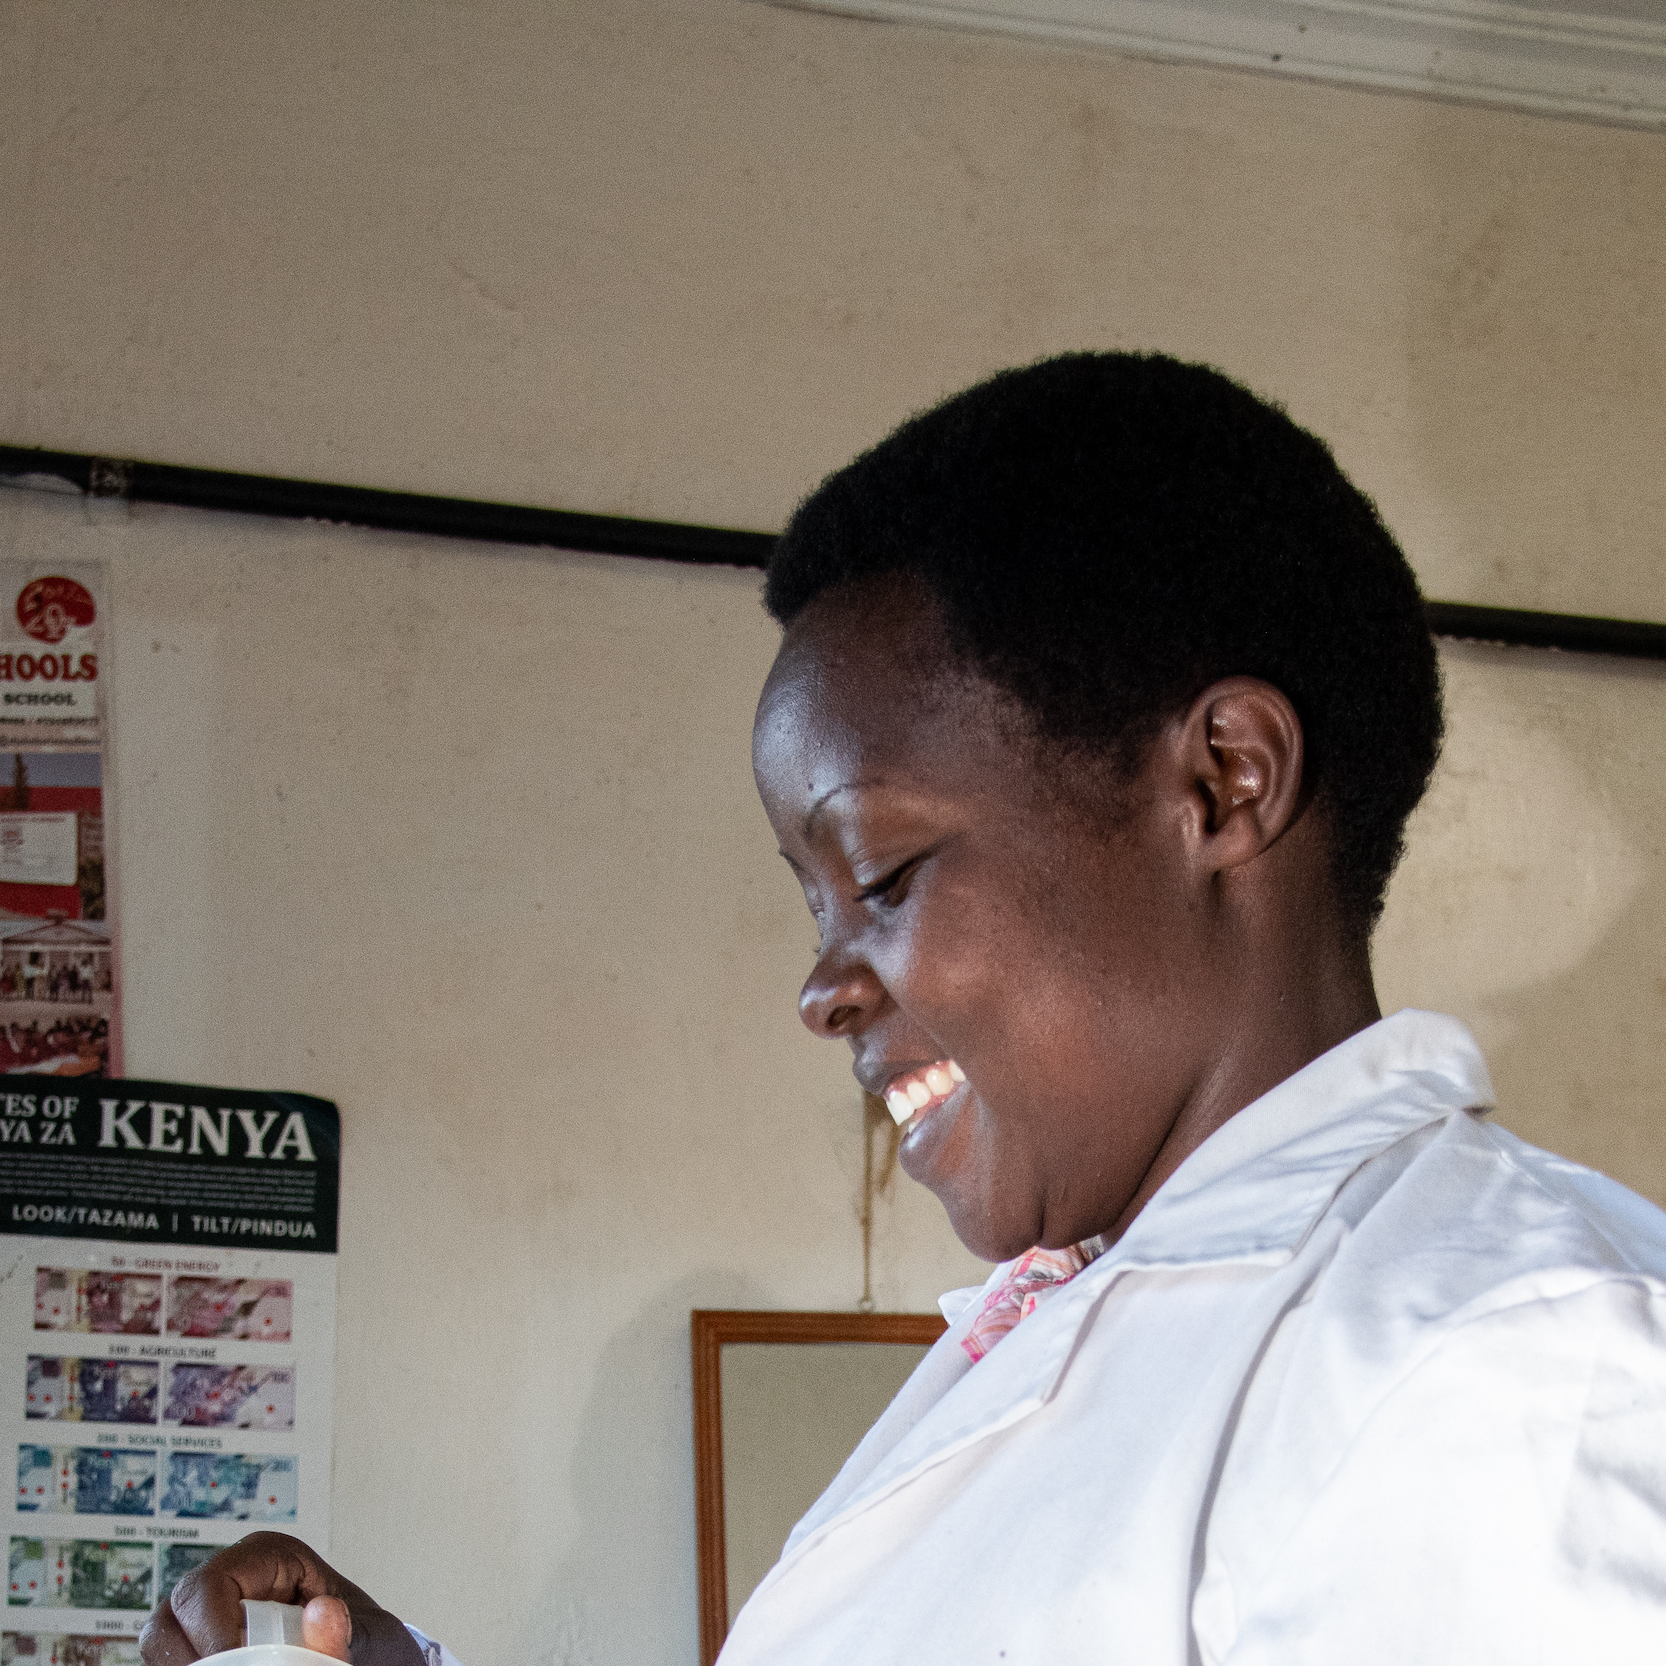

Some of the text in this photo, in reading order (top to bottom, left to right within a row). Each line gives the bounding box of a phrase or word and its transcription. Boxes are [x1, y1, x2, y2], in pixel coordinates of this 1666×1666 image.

[3, 693, 78, 706] SCHOOL
[40, 1121, 77, 1146] ZA
[42, 1096, 79, 1119] OF
[99, 1098, 317, 1162] KENYA
[12, 1205, 159, 1231] LOOK/TAZAMA
[191, 1214, 317, 1239] TILT/PINDUA
[135, 1259, 172, 1271] GREEN
[175, 1261, 221, 1274] ENERGY
[140, 1347, 216, 1359] AGRICULTURE
[128, 1434, 167, 1446] SOCIAL
[170, 1436, 222, 1449] SERVICES
[146, 1528, 199, 1539] TOURISM
